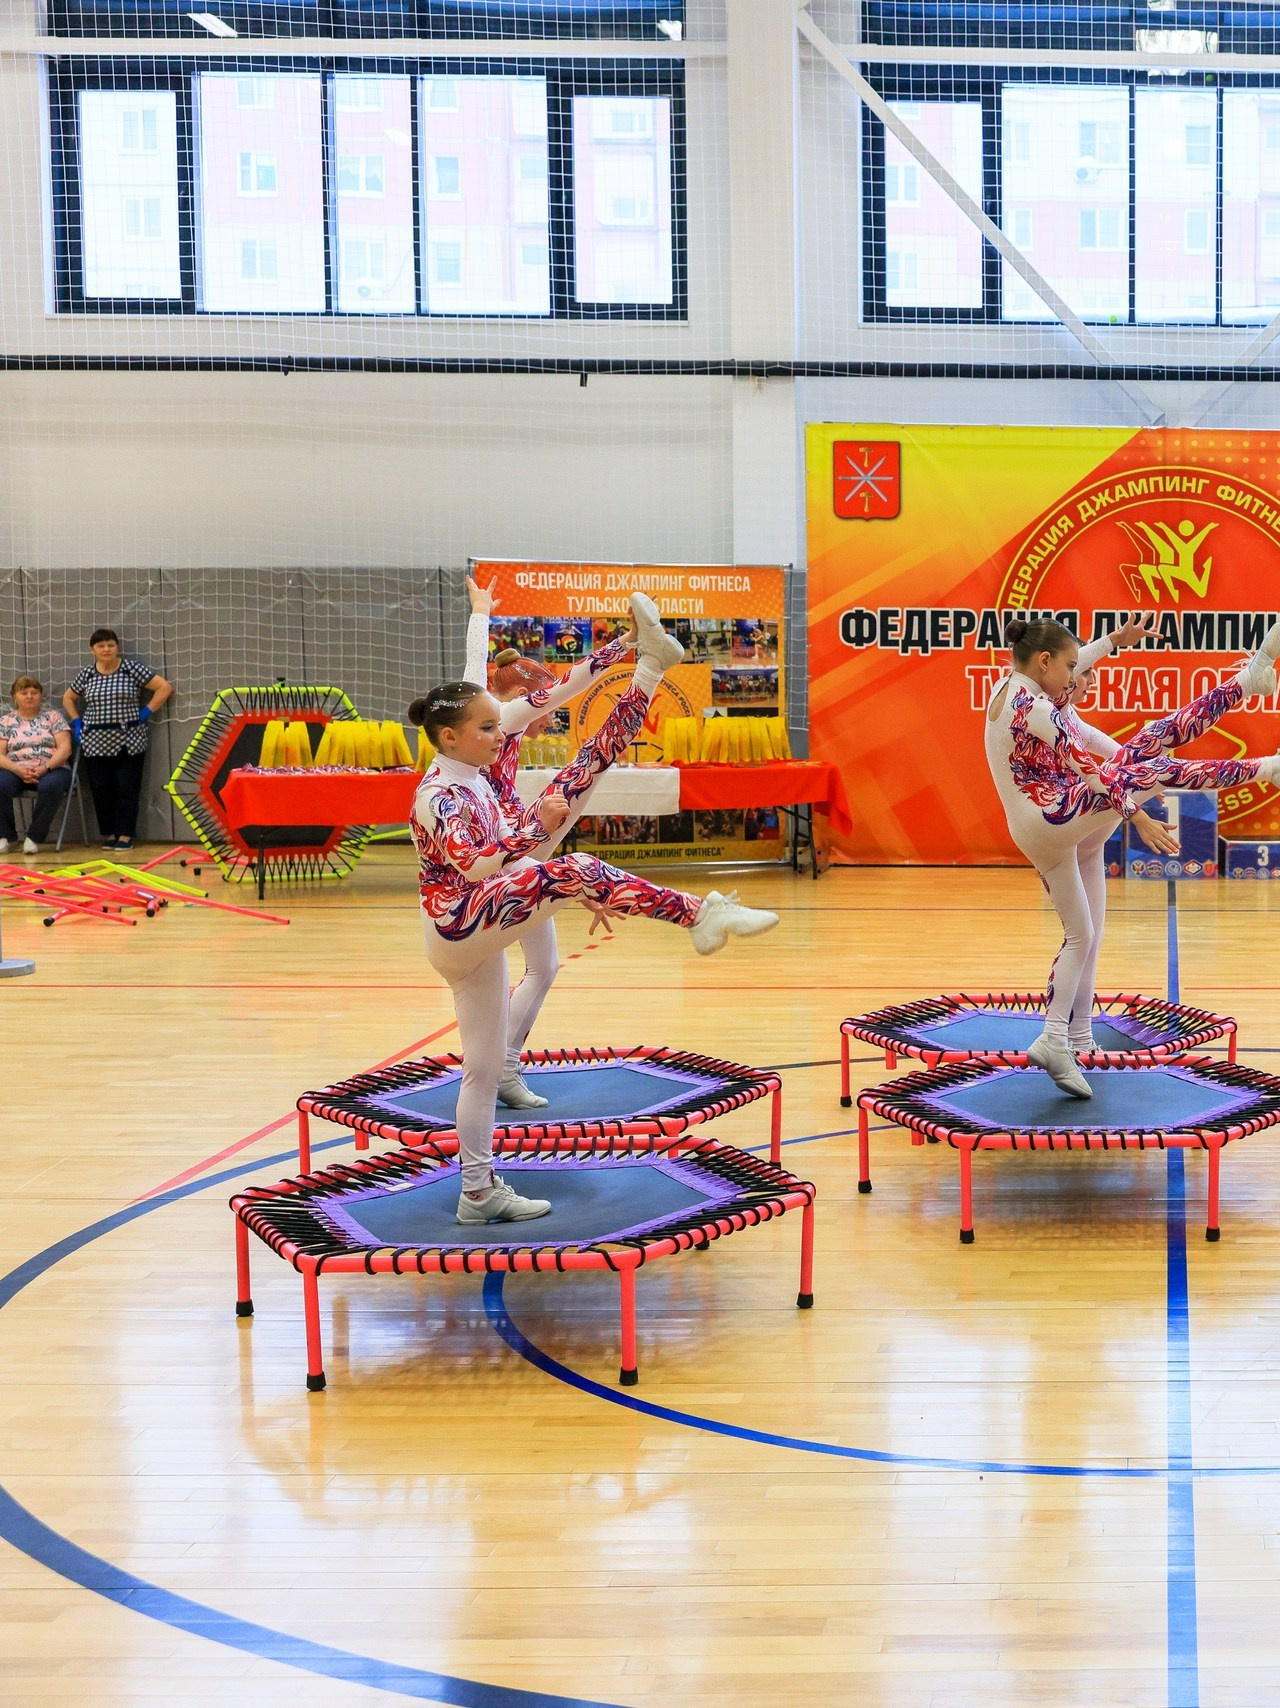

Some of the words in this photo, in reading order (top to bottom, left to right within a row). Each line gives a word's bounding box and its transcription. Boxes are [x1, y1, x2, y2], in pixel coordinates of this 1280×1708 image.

[1007, 514, 1075, 609] ДЕРАЦИЯ
[1076, 475, 1210, 523] ДЖАМПИНГ
[515, 571, 602, 591] ФЕДЕРАЦИЯ
[605, 573, 685, 592] ДЖАМПИНГ
[688, 575, 751, 592] ФИТНЕСА
[566, 596, 631, 614] ТУЛЬСКО
[656, 597, 704, 614] ЛАСТИ
[637, 848, 683, 860] ДЖАМПИНГ
[1257, 845, 1269, 867] 3
